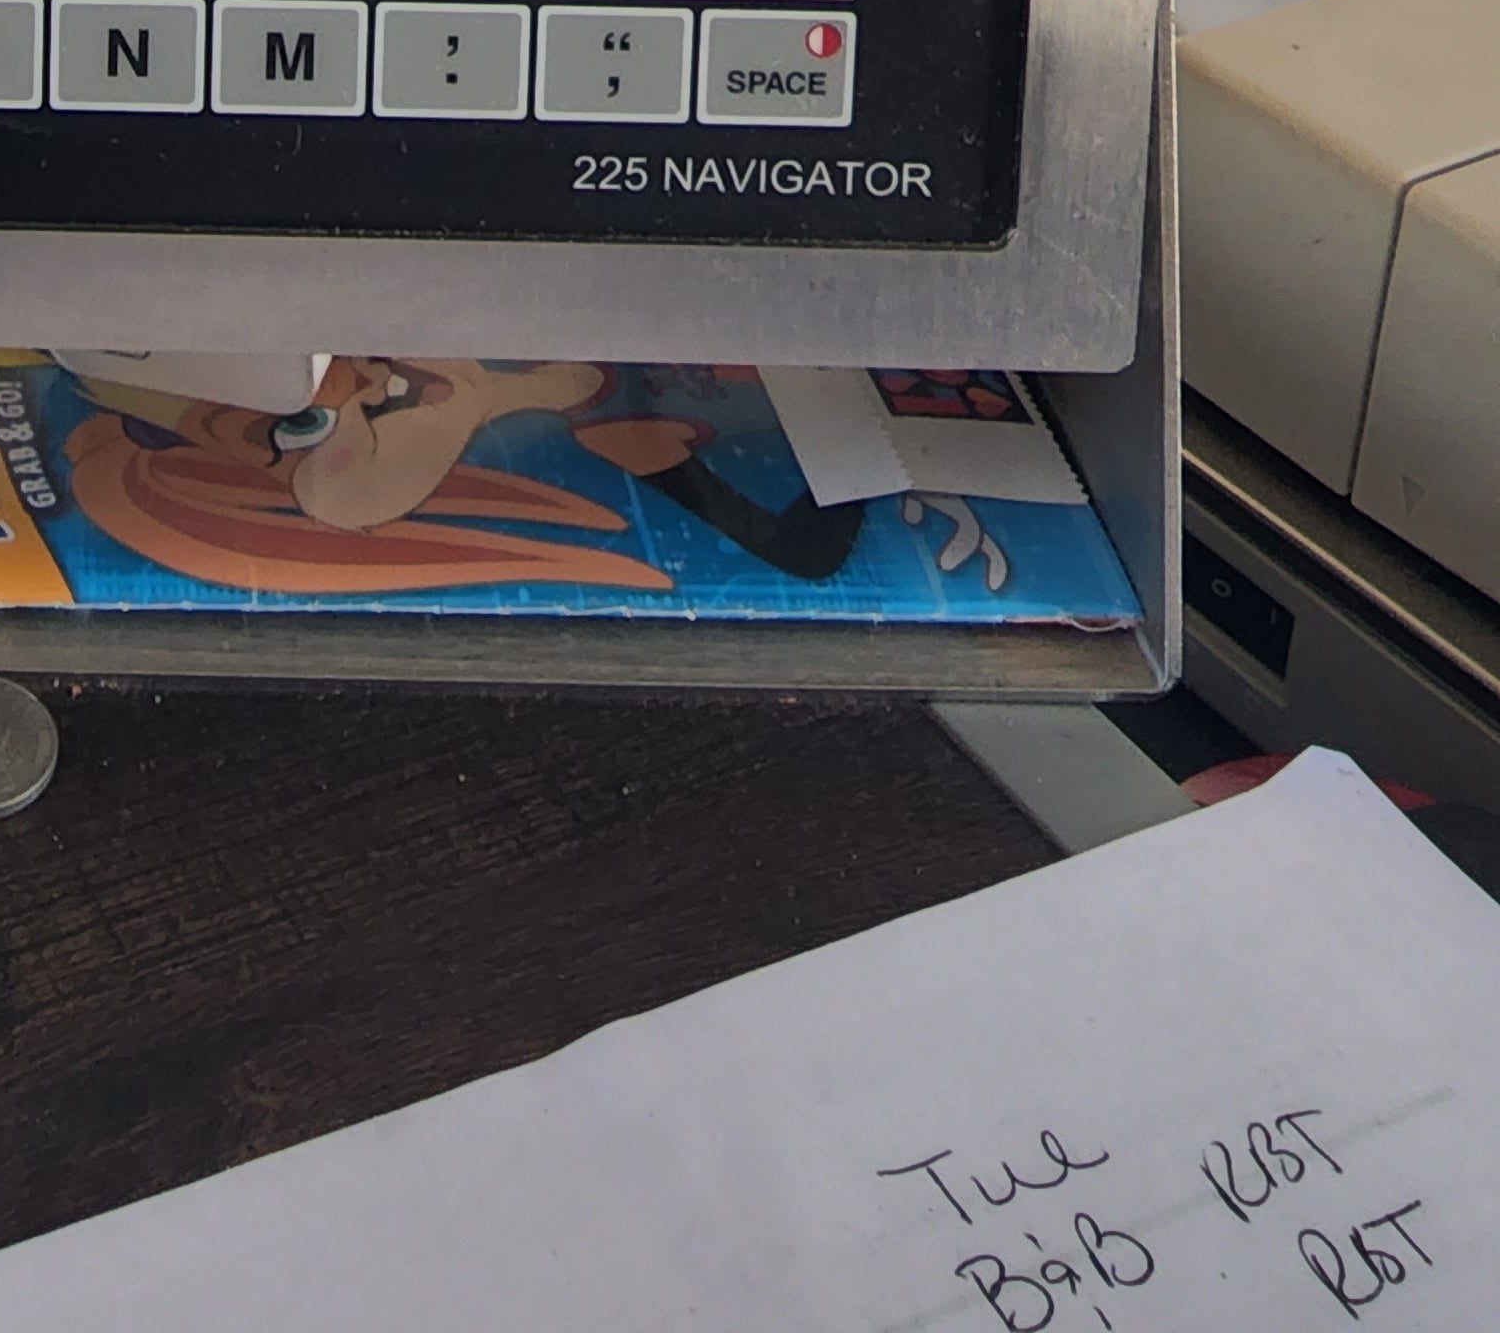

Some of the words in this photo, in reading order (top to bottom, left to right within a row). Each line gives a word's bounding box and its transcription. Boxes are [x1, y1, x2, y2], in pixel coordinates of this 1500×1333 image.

[108, 29, 149, 77] N
[266, 32, 314, 80] M
[726, 70, 826, 96] SPACE
[572, 155, 648, 191] 225
[664, 157, 932, 197] NAVIGATOR
[7, 445, 57, 509] GRAB
